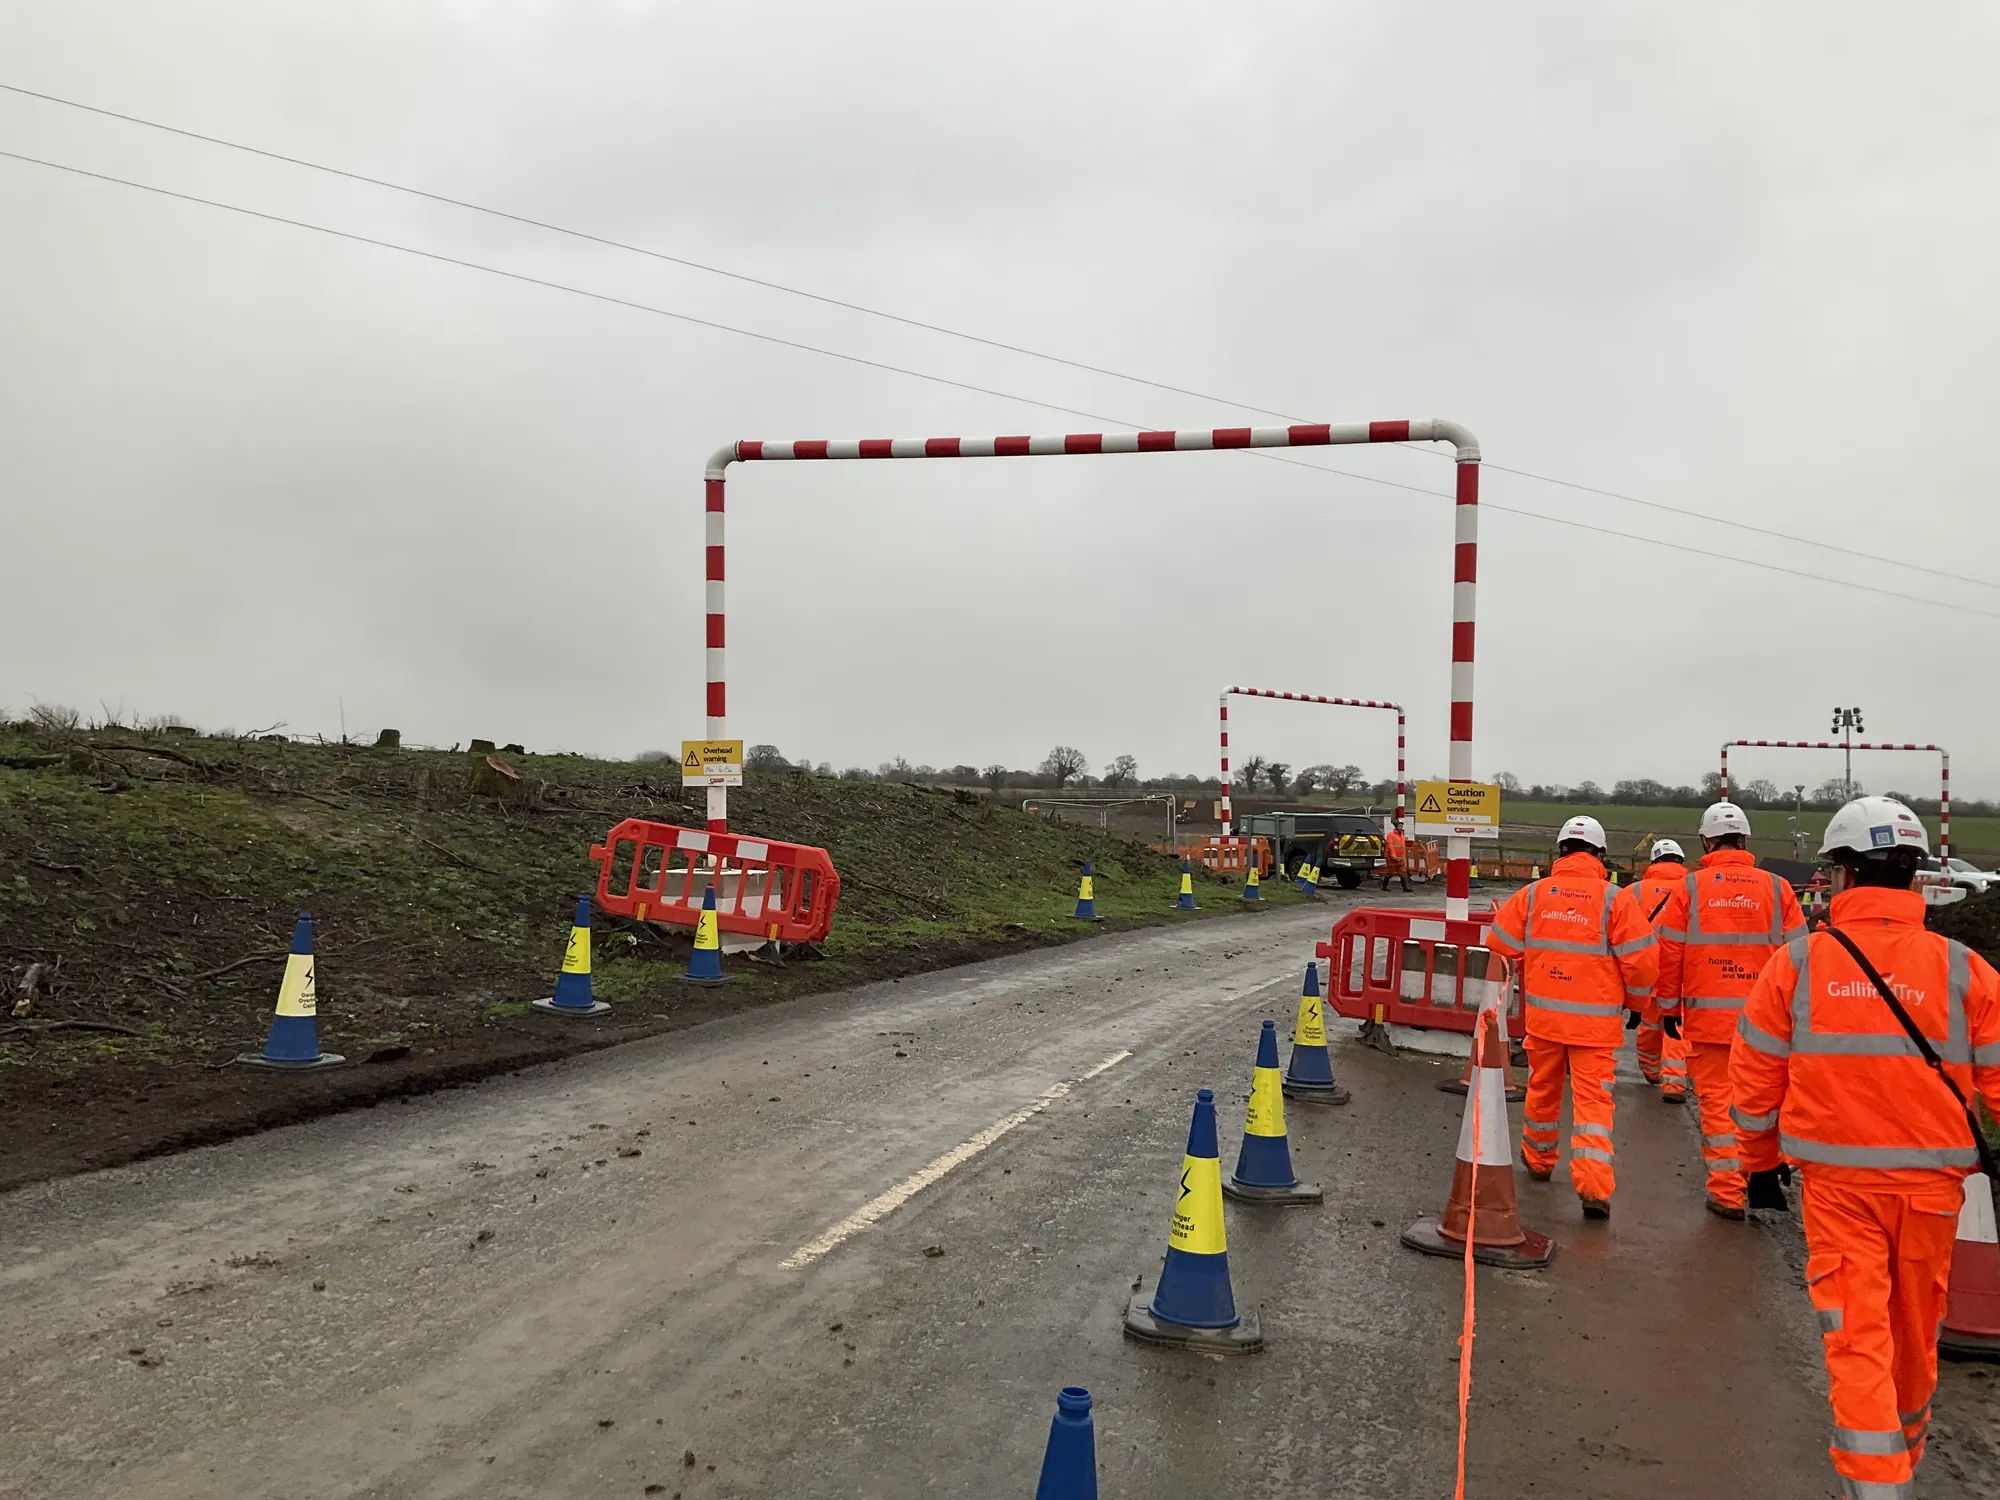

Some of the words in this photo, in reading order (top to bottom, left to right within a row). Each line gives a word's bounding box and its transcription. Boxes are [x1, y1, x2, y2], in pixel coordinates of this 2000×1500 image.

[703, 746, 733, 754] Overhead
[703, 755, 728, 763] warning
[1447, 787, 1485, 798] Caution
[1446, 797, 1480, 805] Overhead
[1446, 805, 1470, 813] service
[1725, 876, 1758, 884] highways
[1560, 891, 1592, 899] highways
[1708, 957, 1733, 965] home
[1722, 964, 1744, 973] safe
[1736, 971, 1759, 980] well
